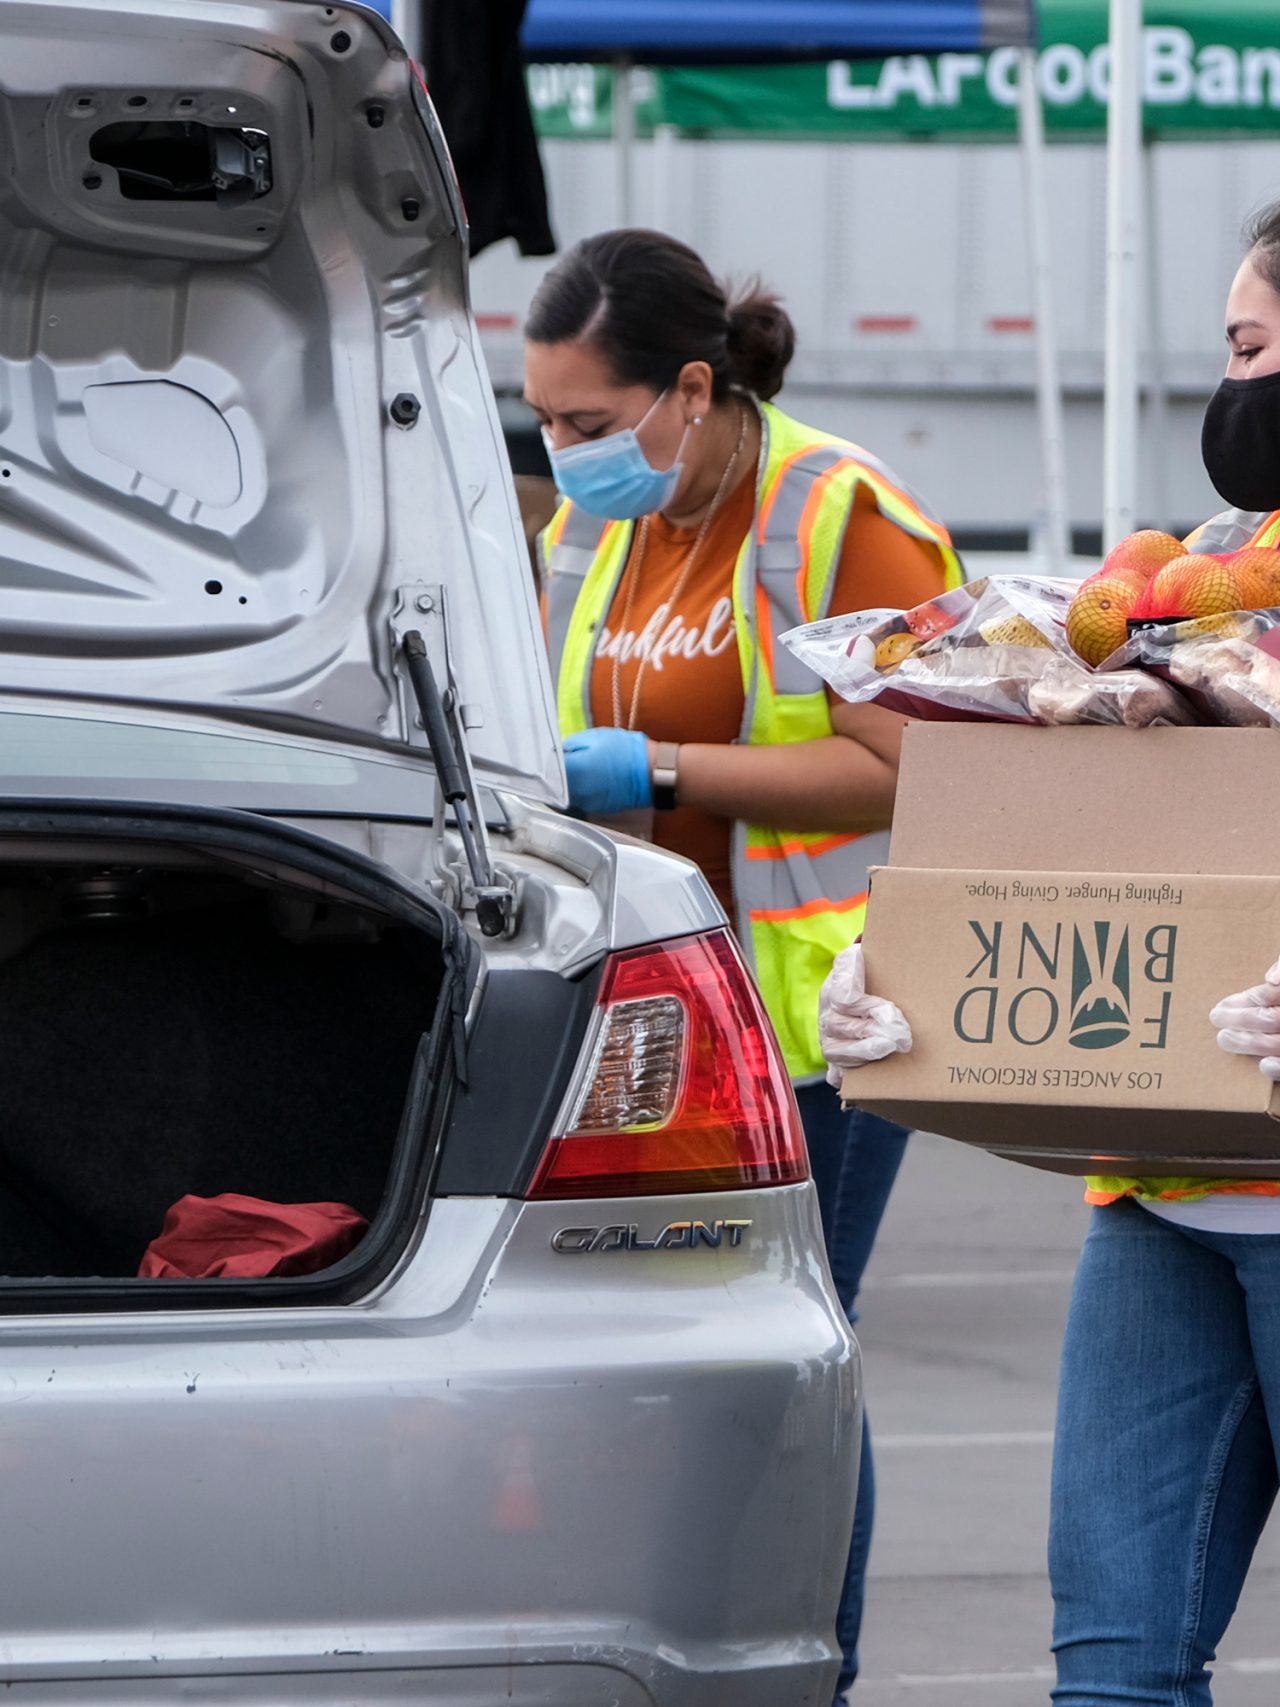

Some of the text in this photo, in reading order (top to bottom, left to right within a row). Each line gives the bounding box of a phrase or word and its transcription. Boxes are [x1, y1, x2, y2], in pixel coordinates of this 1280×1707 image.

[964, 879, 1183, 905] Fighting Hunger. Giving Hope.
[946, 1065, 1163, 1090] LOS ANGELES REGIONAL
[552, 1219, 753, 1254] GALANT
